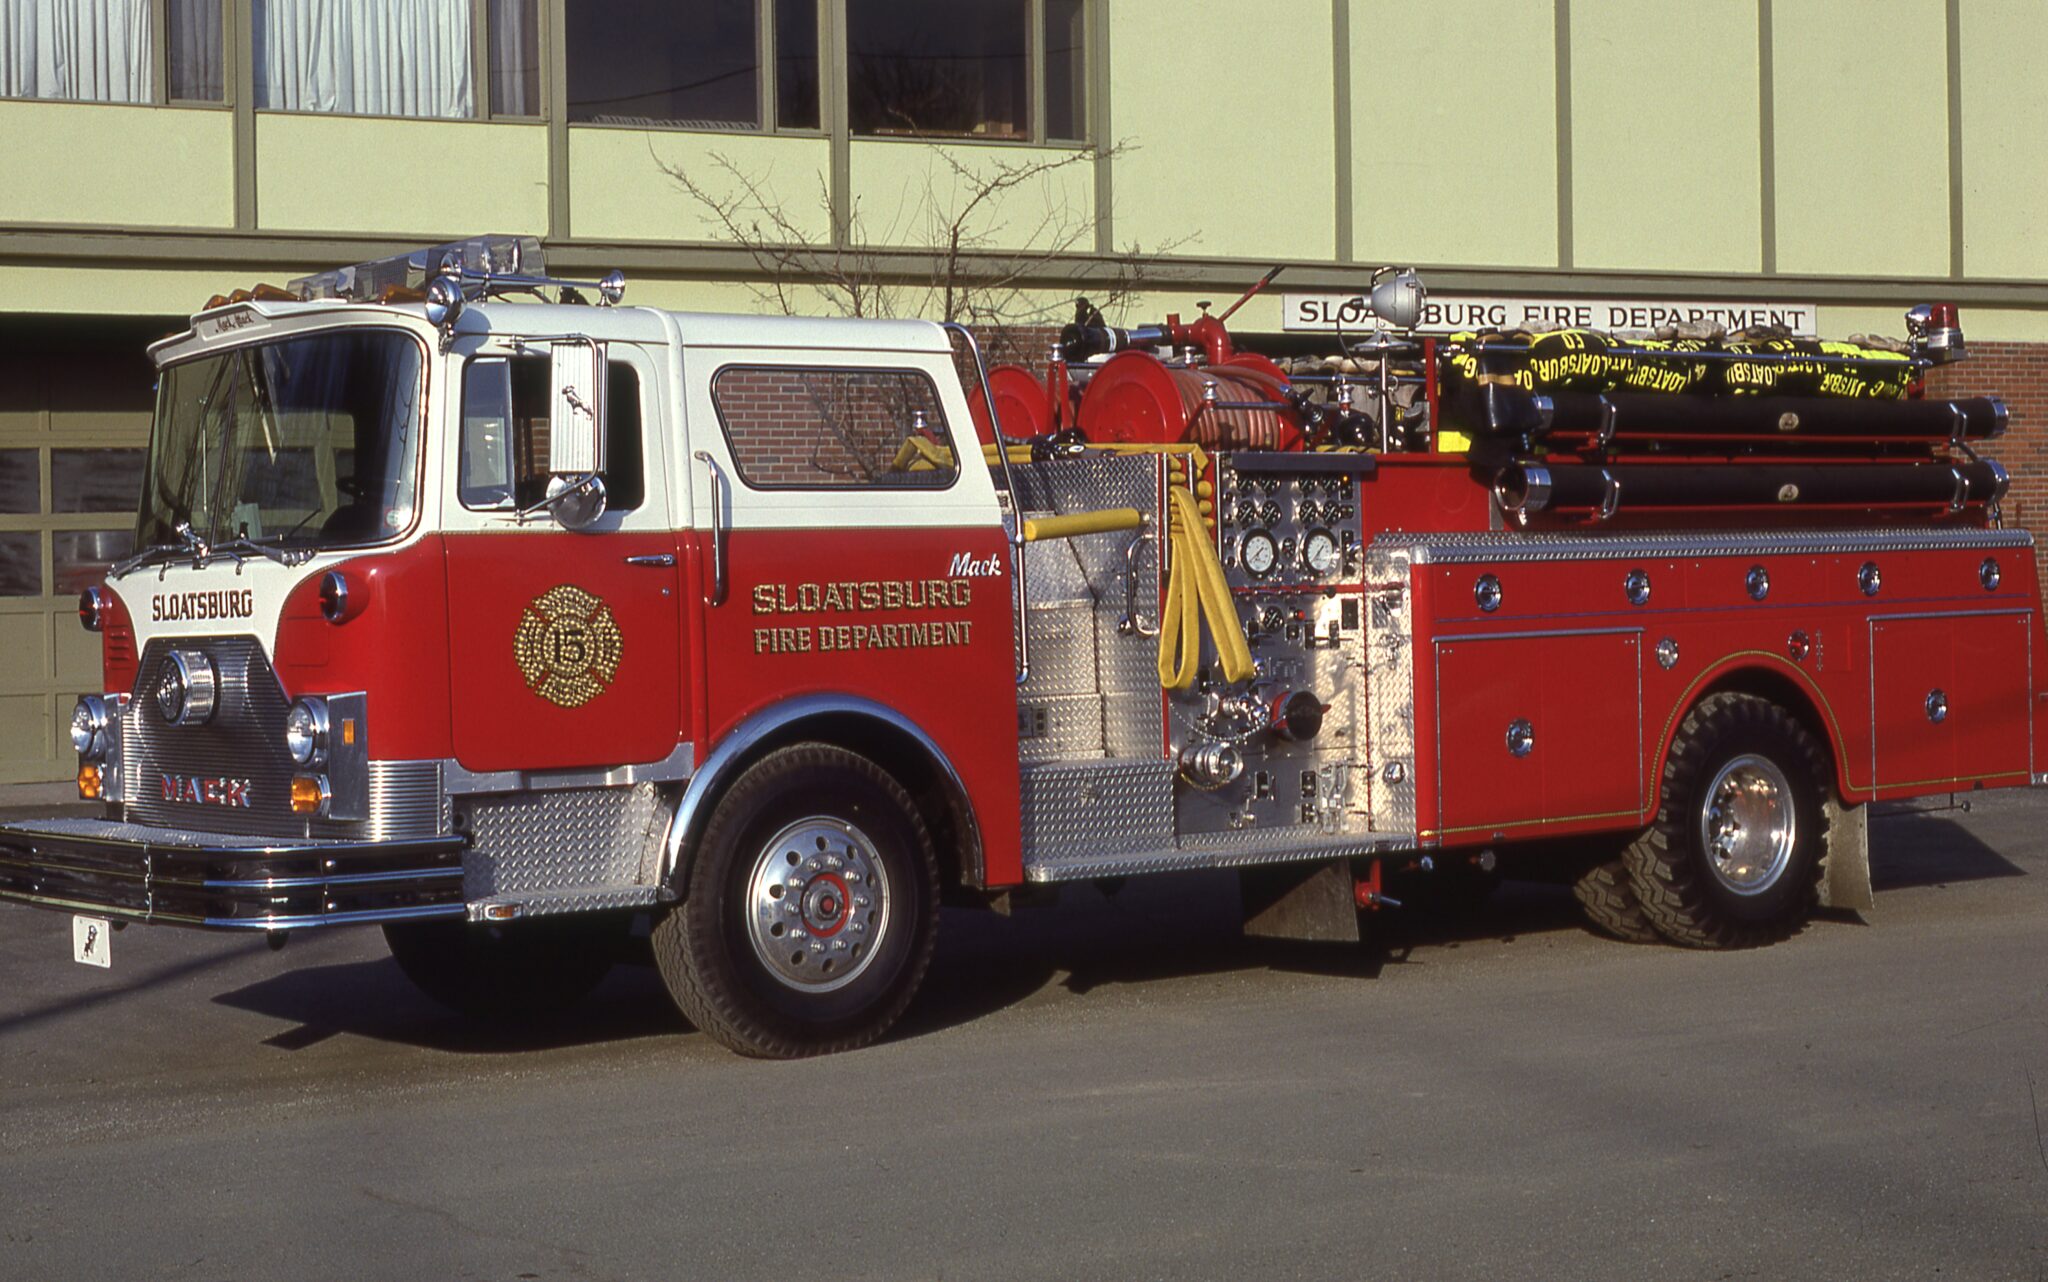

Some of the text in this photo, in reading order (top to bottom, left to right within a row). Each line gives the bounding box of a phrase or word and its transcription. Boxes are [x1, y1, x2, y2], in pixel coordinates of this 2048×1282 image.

[1299, 300, 1806, 330] SLOABURG FIRE DEPARTMENT
[948, 552, 1003, 577] Mack
[152, 589, 253, 622] SLOATSBURG
[753, 579, 972, 615] SLOATSBURG
[554, 629, 586, 664] 15
[754, 620, 973, 655] FIRE DEPARTMENT
[161, 774, 251, 808] MACK
